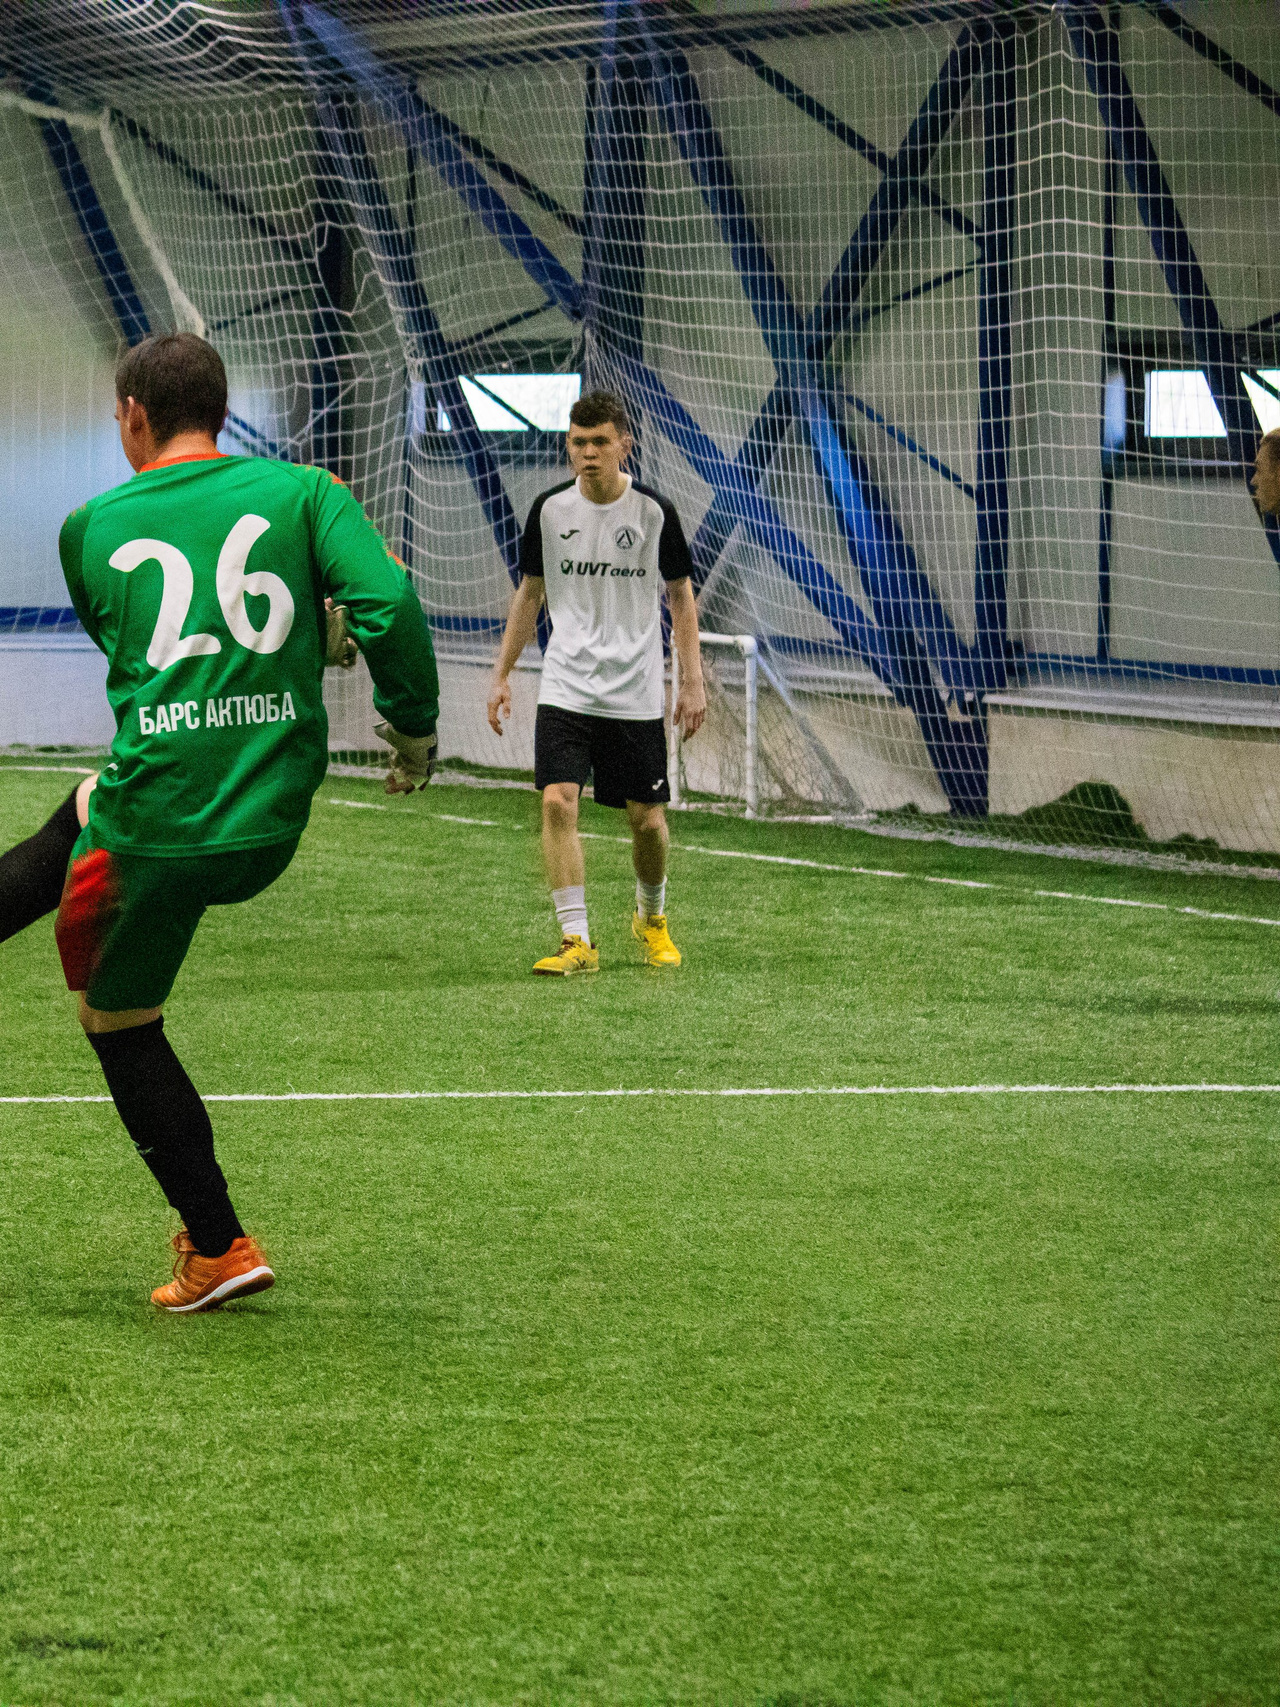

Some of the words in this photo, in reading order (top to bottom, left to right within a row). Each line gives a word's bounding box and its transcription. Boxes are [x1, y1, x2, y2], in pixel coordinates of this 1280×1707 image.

[108, 513, 295, 672] 26
[138, 700, 200, 735] БАРС
[205, 691, 297, 728] АКТЮБА
